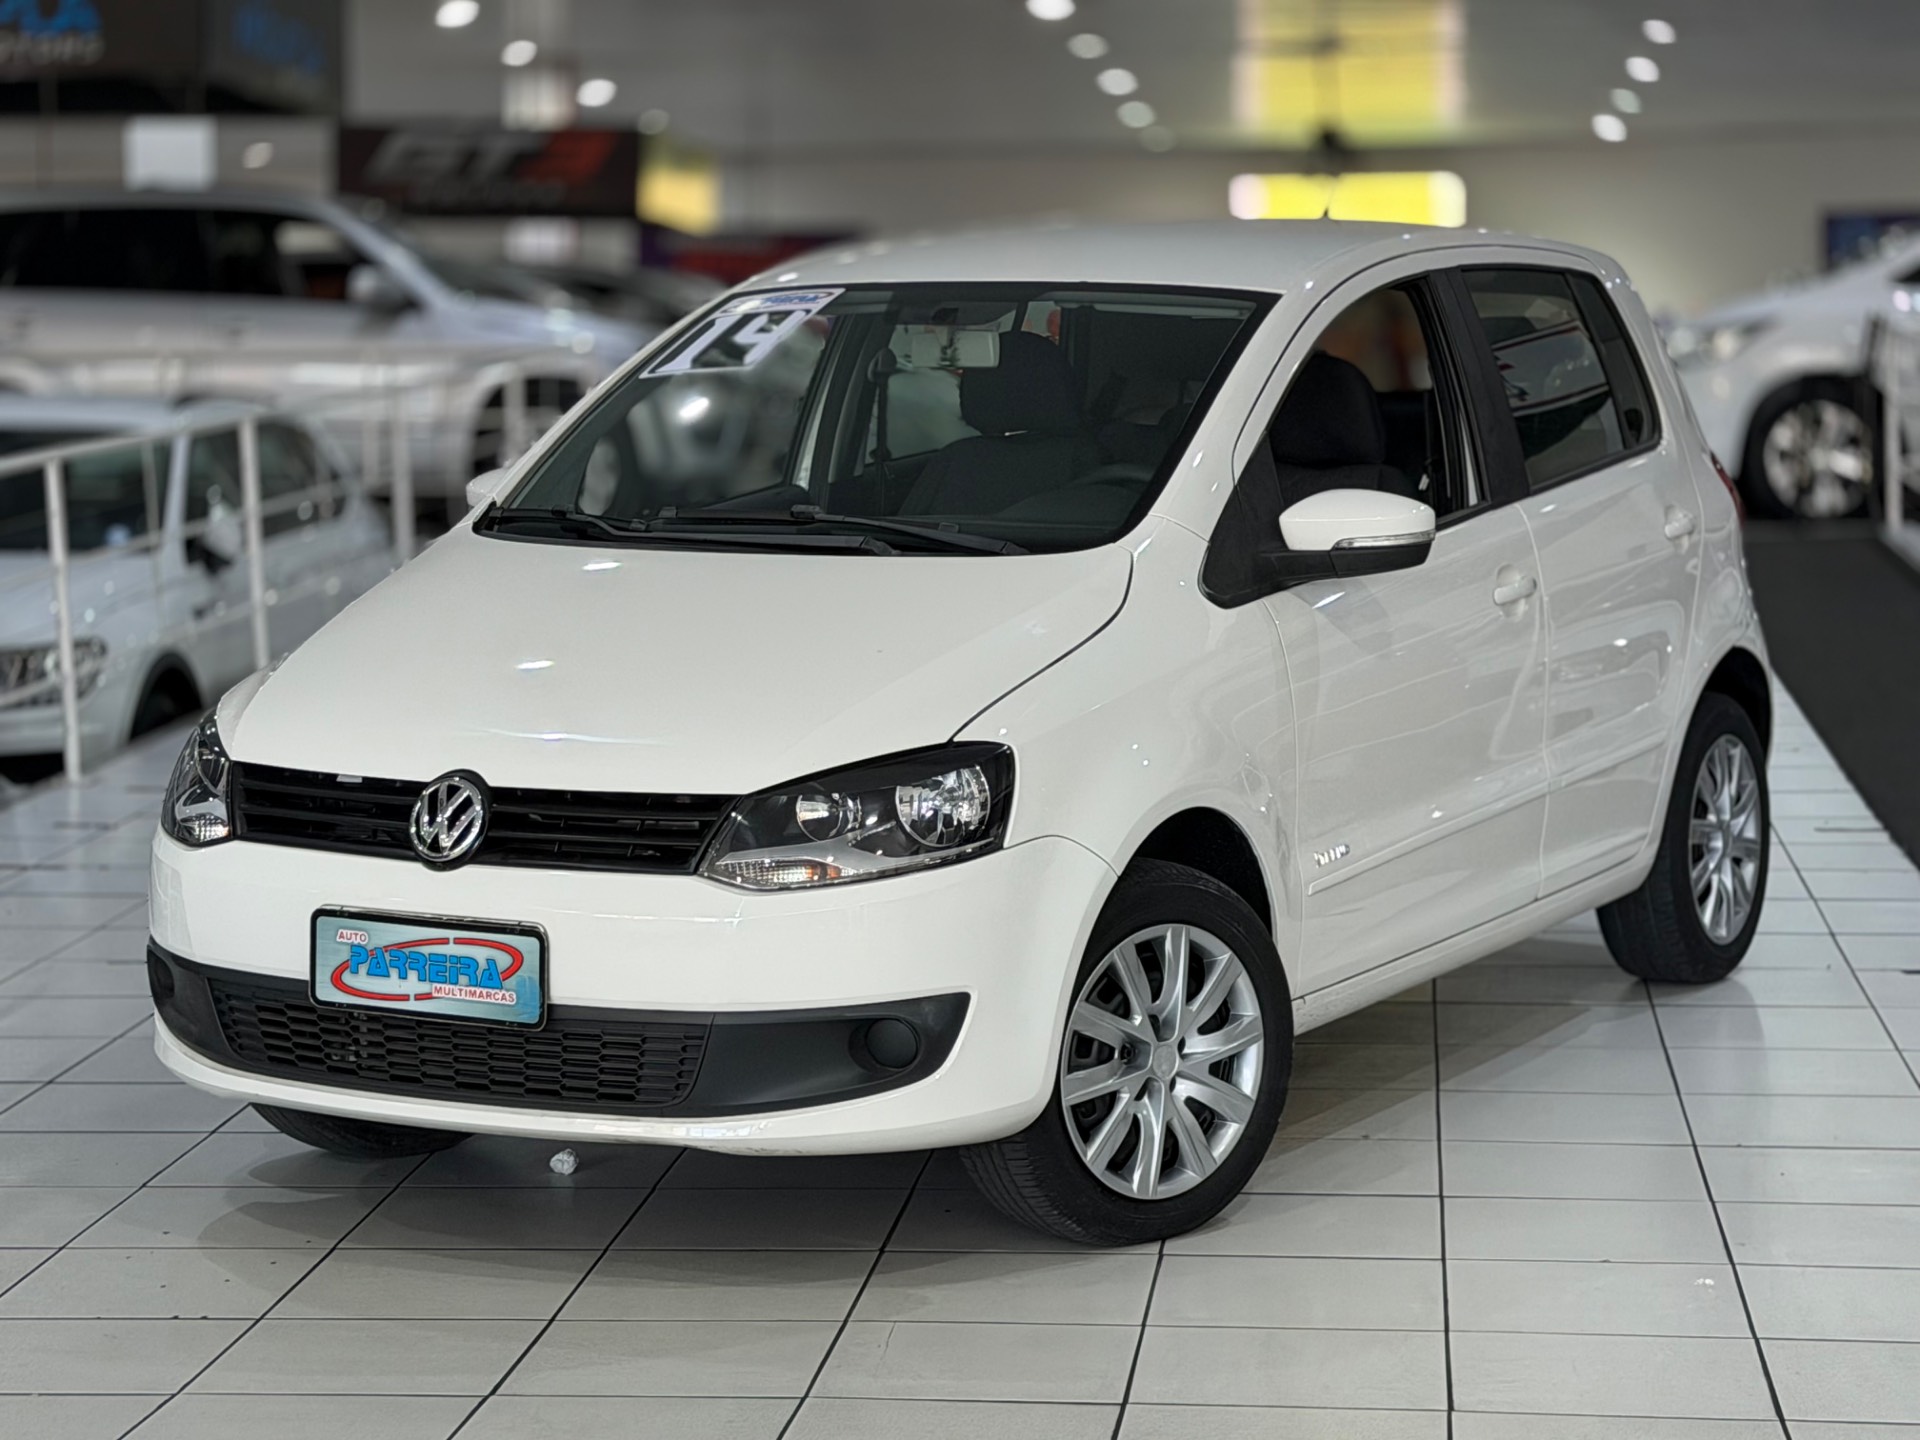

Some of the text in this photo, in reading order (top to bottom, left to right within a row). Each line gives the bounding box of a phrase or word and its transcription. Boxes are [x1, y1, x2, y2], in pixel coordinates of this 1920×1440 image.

[337, 930, 369, 943] AUTO
[349, 944, 504, 990] PARREIRA
[432, 986, 517, 1004] MULTIMARCAS
